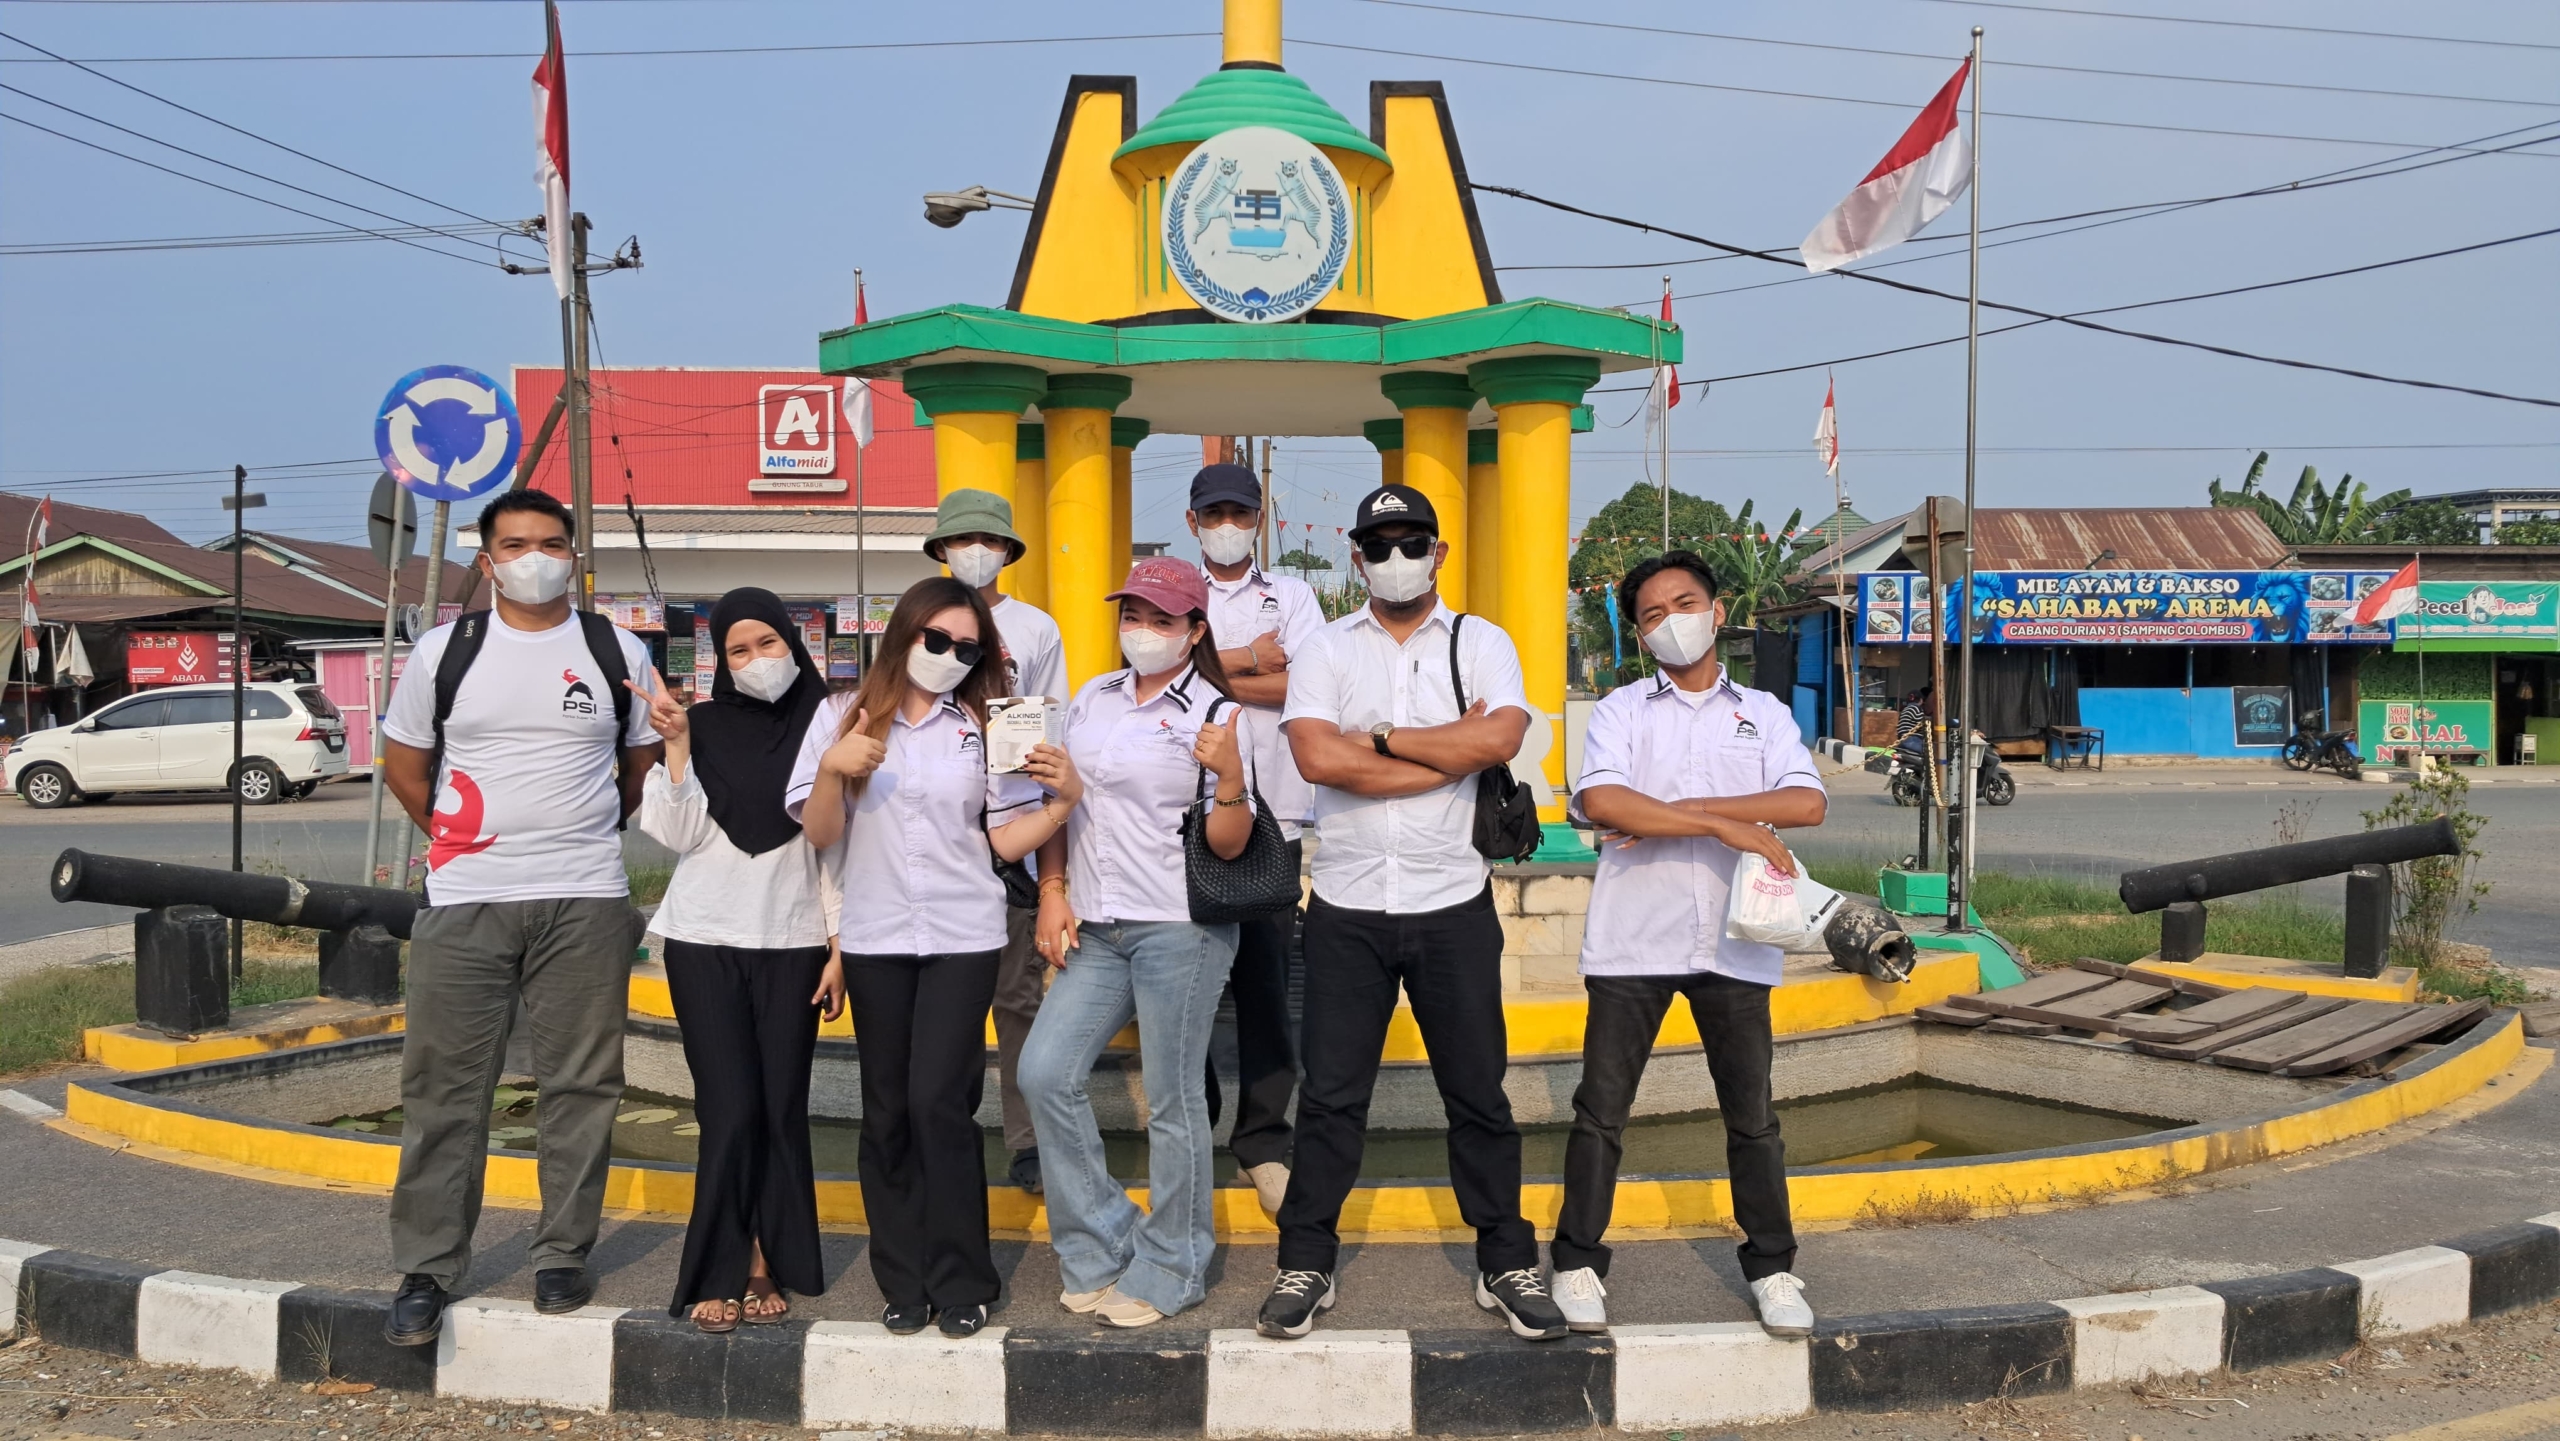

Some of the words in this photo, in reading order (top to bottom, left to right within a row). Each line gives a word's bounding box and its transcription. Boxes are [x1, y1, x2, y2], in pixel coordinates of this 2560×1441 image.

[766, 456, 828, 468] Alfamidi
[1134, 565, 1156, 579] NEW
[1153, 565, 1183, 586] YORK
[2016, 578, 2060, 594] MIE
[2064, 578, 2133, 594] AYAM
[2136, 578, 2156, 594] &
[2160, 578, 2240, 594] BAKSO
[2164, 598, 2274, 618] AREMA
[2414, 599, 2468, 615] Pecel
[2489, 598, 2537, 615] Joss
[464, 620, 475, 637] torch
[2009, 625, 2059, 636] CABANG
[2061, 625, 2106, 636] DURIAN
[2108, 625, 2116, 636] 3
[2117, 625, 2175, 637] (SAMPING
[2177, 625, 2246, 637] COLOMBUS)
[171, 674, 206, 682] ABATA
[563, 700, 597, 714] PSI
[2390, 707, 2409, 715] SOTO
[2390, 715, 2409, 724] AYAM
[1736, 727, 1758, 737] PSI
[2384, 725, 2467, 742] ALAL
